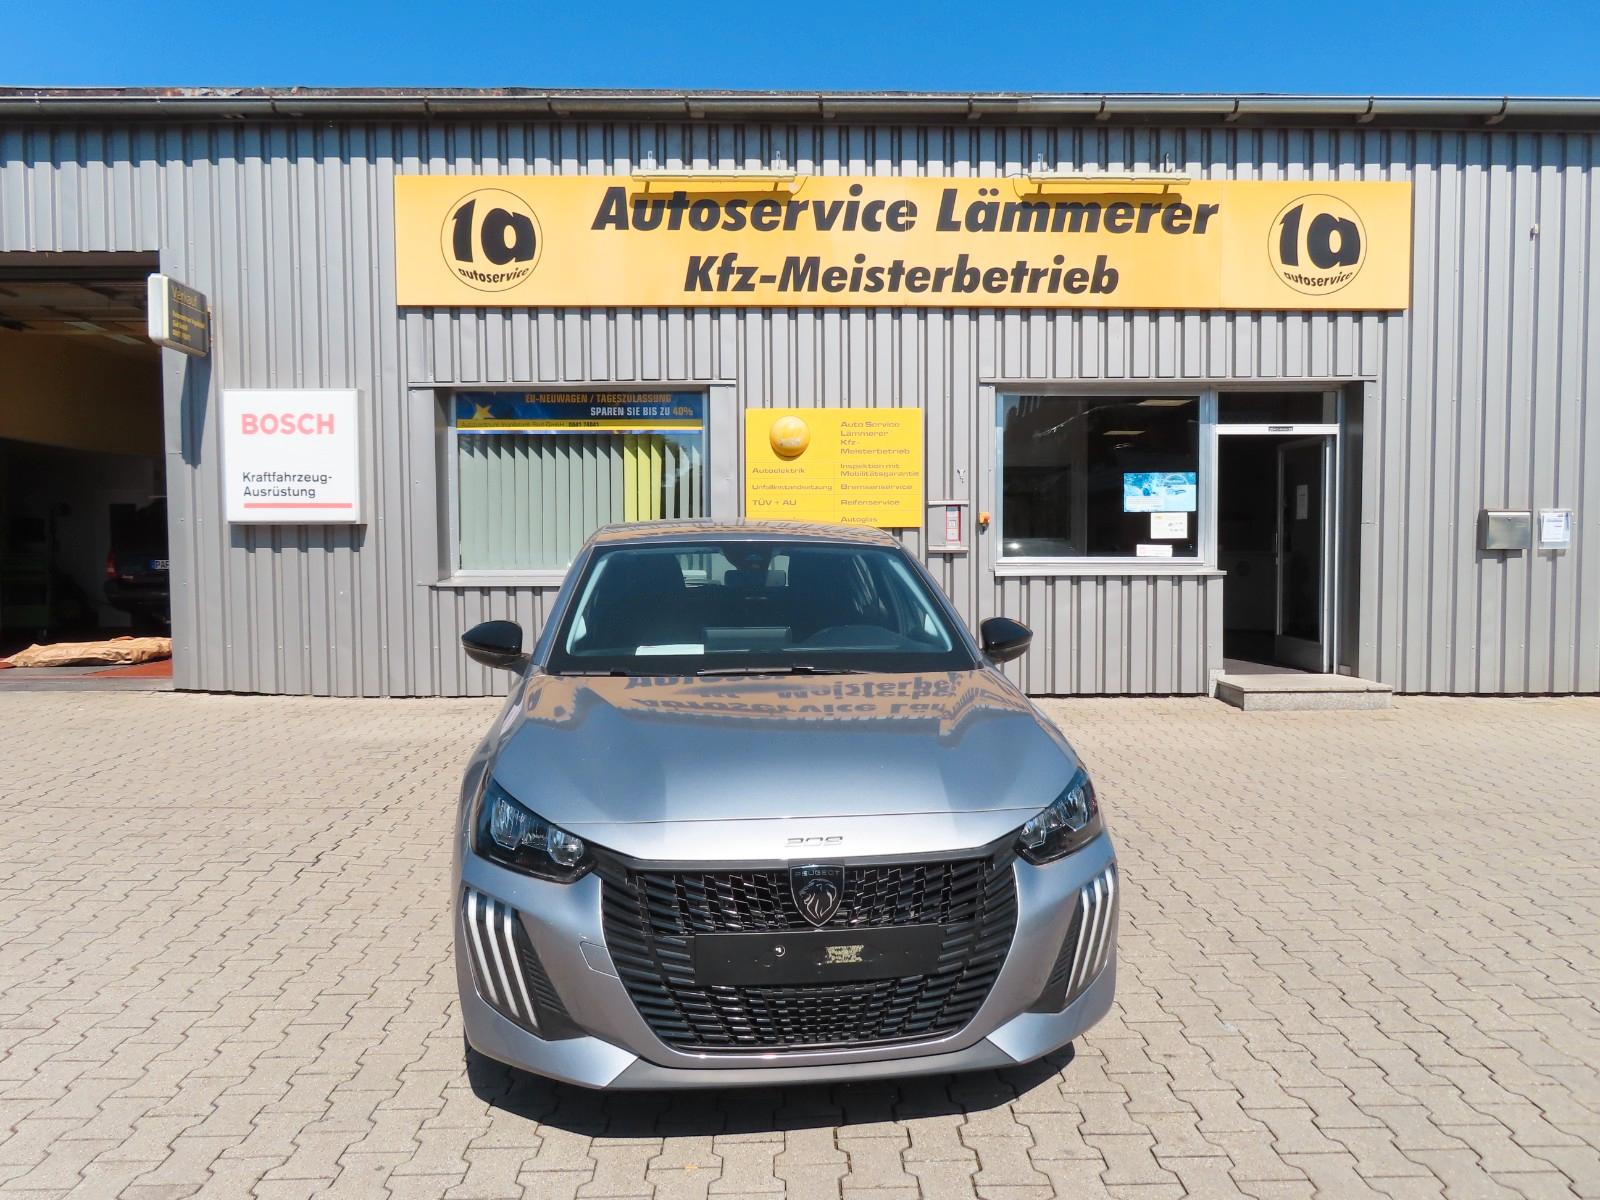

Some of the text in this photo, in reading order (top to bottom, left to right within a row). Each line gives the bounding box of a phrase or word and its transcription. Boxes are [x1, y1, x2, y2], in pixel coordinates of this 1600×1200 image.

[591, 184, 1219, 235] Autoservice Lämmerer
[458, 267, 529, 283] autoservice
[684, 253, 1120, 295] Kfz-Meisterbetrieb
[1283, 270, 1354, 287] autoservice
[596, 393, 672, 404] TAGESZULASSUNG
[590, 407, 694, 416] SPAREN SIE BIS ZU 40%
[241, 413, 335, 435] BOSCH
[242, 471, 333, 485] Kraftfahrzeug-
[243, 486, 316, 498] Ausrüstung
[752, 498, 772, 506] TÜV
[841, 516, 878, 524] Autoglas
[784, 836, 843, 848] 208
